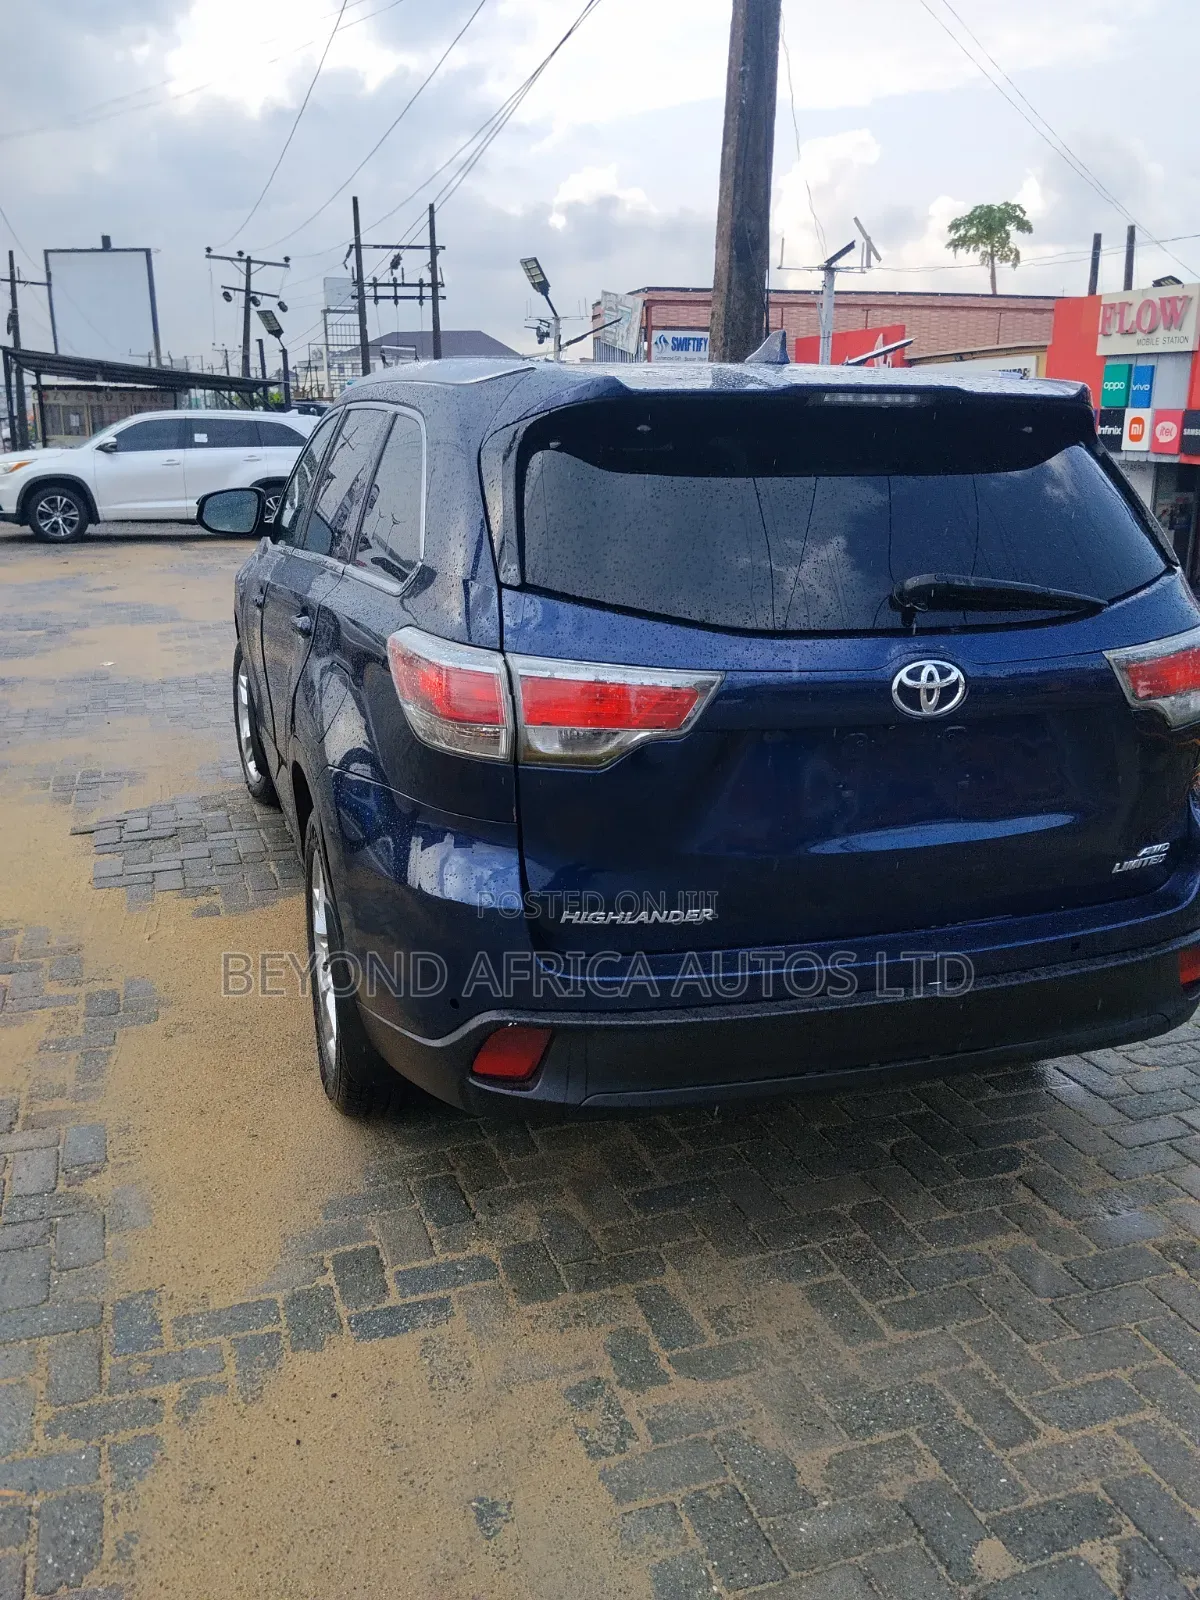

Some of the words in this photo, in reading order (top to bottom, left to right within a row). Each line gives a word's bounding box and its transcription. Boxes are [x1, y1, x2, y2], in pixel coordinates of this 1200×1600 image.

[1098, 296, 1191, 336] FLOW
[671, 336, 708, 352] SWIFTIFY
[1136, 338, 1159, 346] MOBILE
[1162, 336, 1189, 345] STATION
[1103, 381, 1125, 391] oppo
[1132, 383, 1150, 391] vivo
[1160, 424, 1173, 437] itel
[1111, 853, 1167, 874] LIMITED
[560, 908, 714, 925] HIGHLANDER
